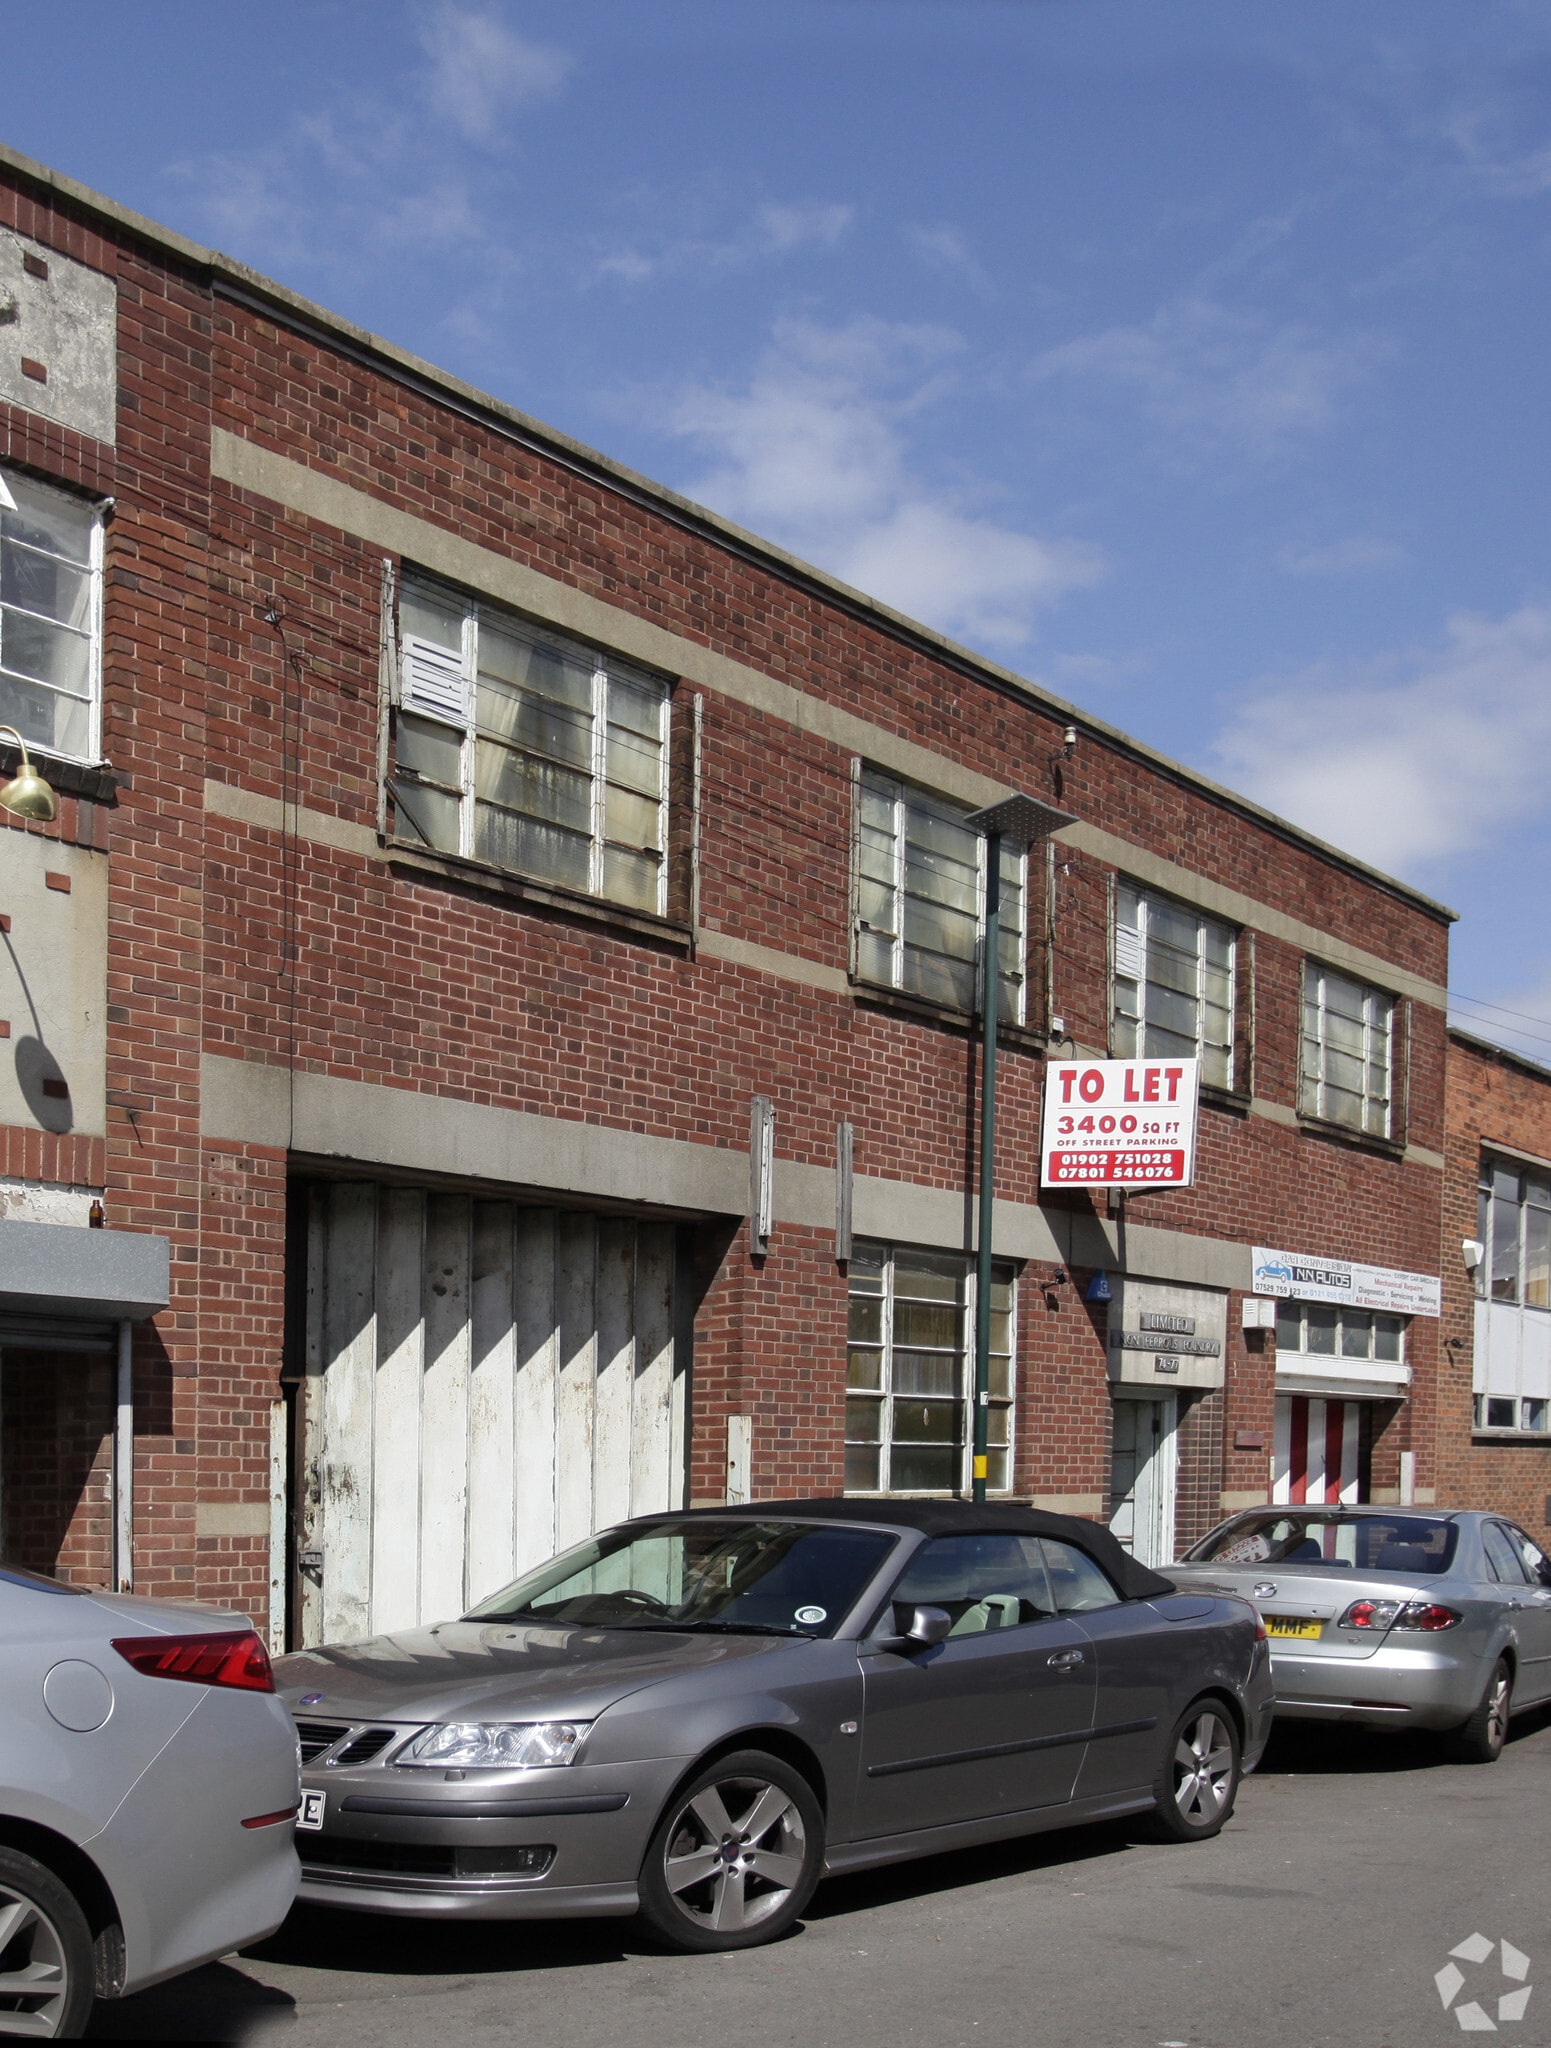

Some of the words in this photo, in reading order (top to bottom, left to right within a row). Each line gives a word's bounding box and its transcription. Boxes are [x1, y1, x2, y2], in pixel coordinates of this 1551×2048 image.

[1059, 1069, 1104, 1103] TO
[1124, 1068, 1183, 1102] LET
[1057, 1115, 1137, 1134] 3400
[1142, 1122, 1160, 1134] SQ
[1165, 1122, 1180, 1133] FT
[1127, 1138, 1178, 1146] PARKING
[1061, 1154, 1108, 1165] 01902
[1114, 1153, 1172, 1165] 751028
[1058, 1167, 1105, 1178] 07801
[1113, 1167, 1173, 1178] 546076
[1281, 1254, 1298, 1265] CAR
[1316, 1271, 1350, 1287] AUTOS
[1374, 1278, 1403, 1288] Mechanical
[1404, 1283, 1424, 1292] Repairs
[1358, 1286, 1386, 1296] Diagnostic
[1390, 1291, 1414, 1302] Servicing
[1418, 1295, 1437, 1305] Welding
[1364, 1297, 1389, 1307] Electrical
[1390, 1301, 1409, 1310] Repairs
[1150, 1314, 1188, 1331] LIMITED
[1144, 1336, 1178, 1350] FERROUS
[1159, 1357, 1179, 1369] 74-77
[1271, 1618, 1312, 1635] MMF
